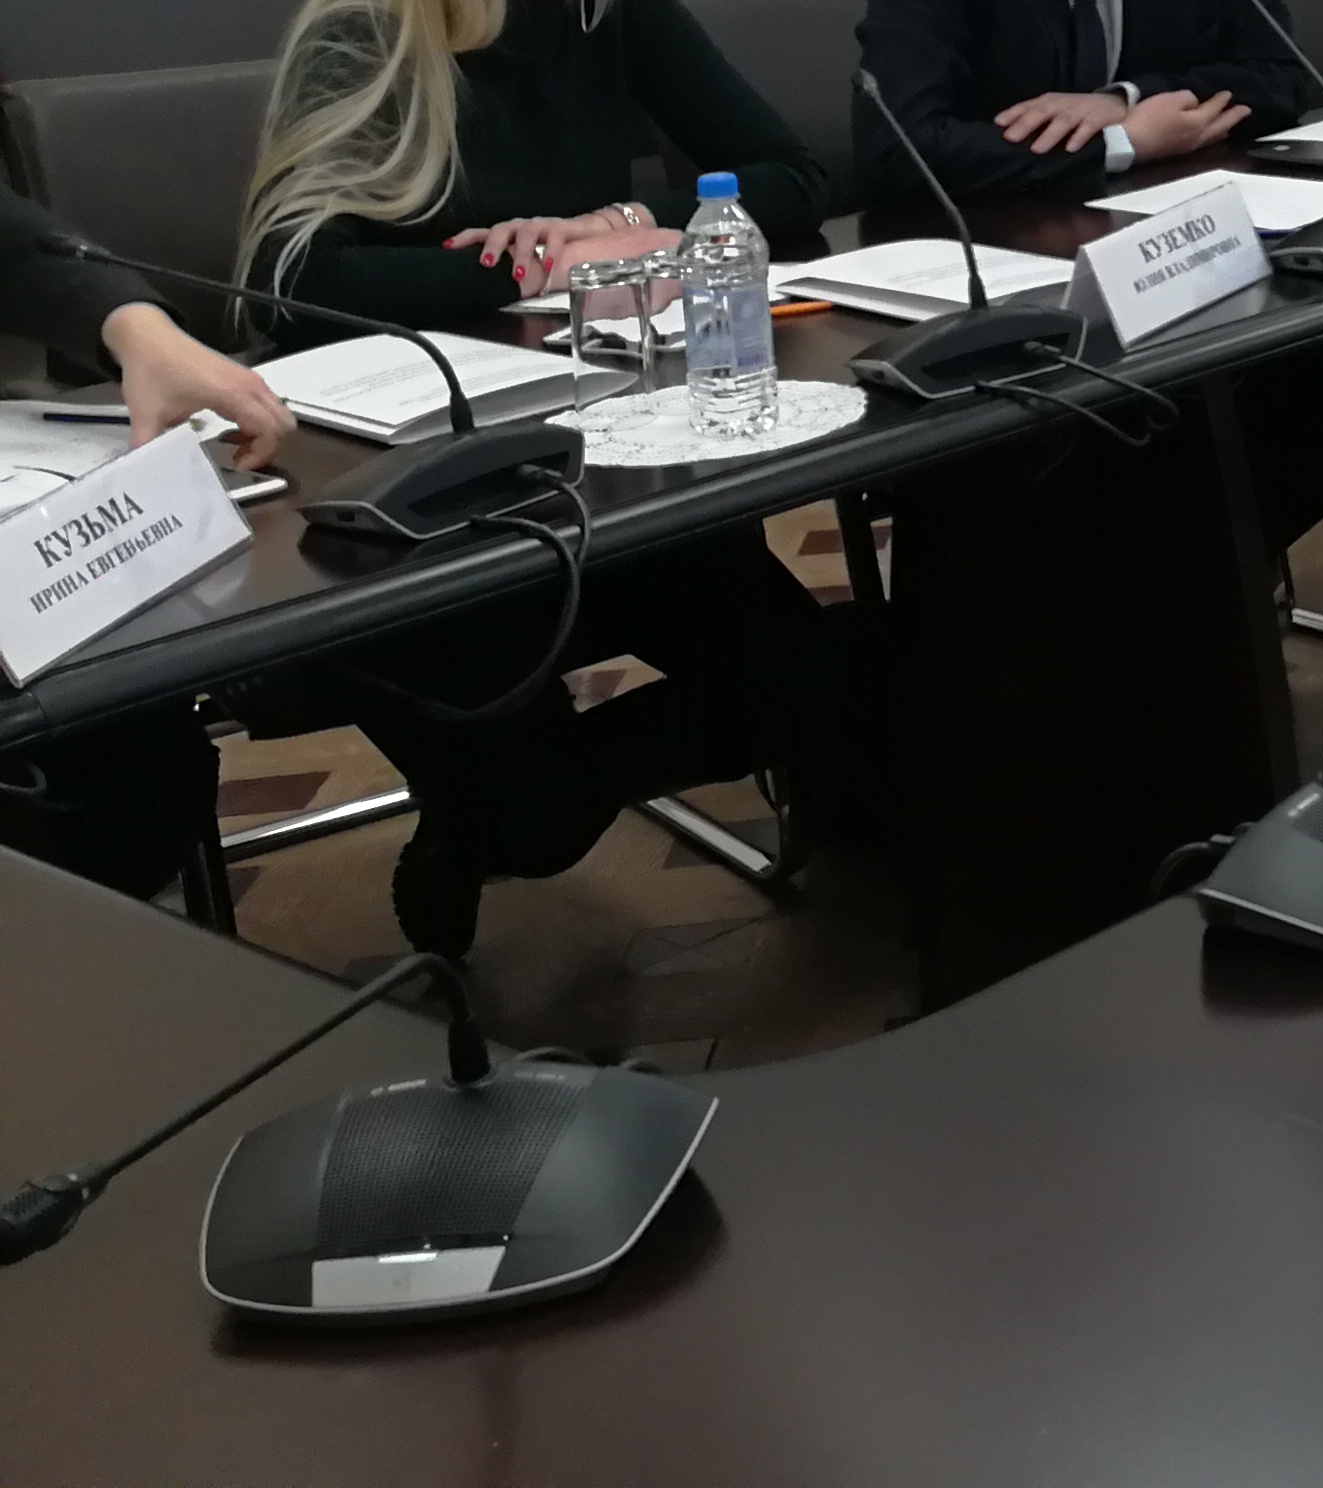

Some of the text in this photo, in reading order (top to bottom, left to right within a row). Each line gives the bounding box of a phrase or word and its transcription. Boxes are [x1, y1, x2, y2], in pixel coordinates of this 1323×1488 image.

[1138, 214, 1216, 263] КУЗЕМКО
[33, 492, 145, 568] КУЗЬМА
[30, 570, 90, 614] ИРИНА
